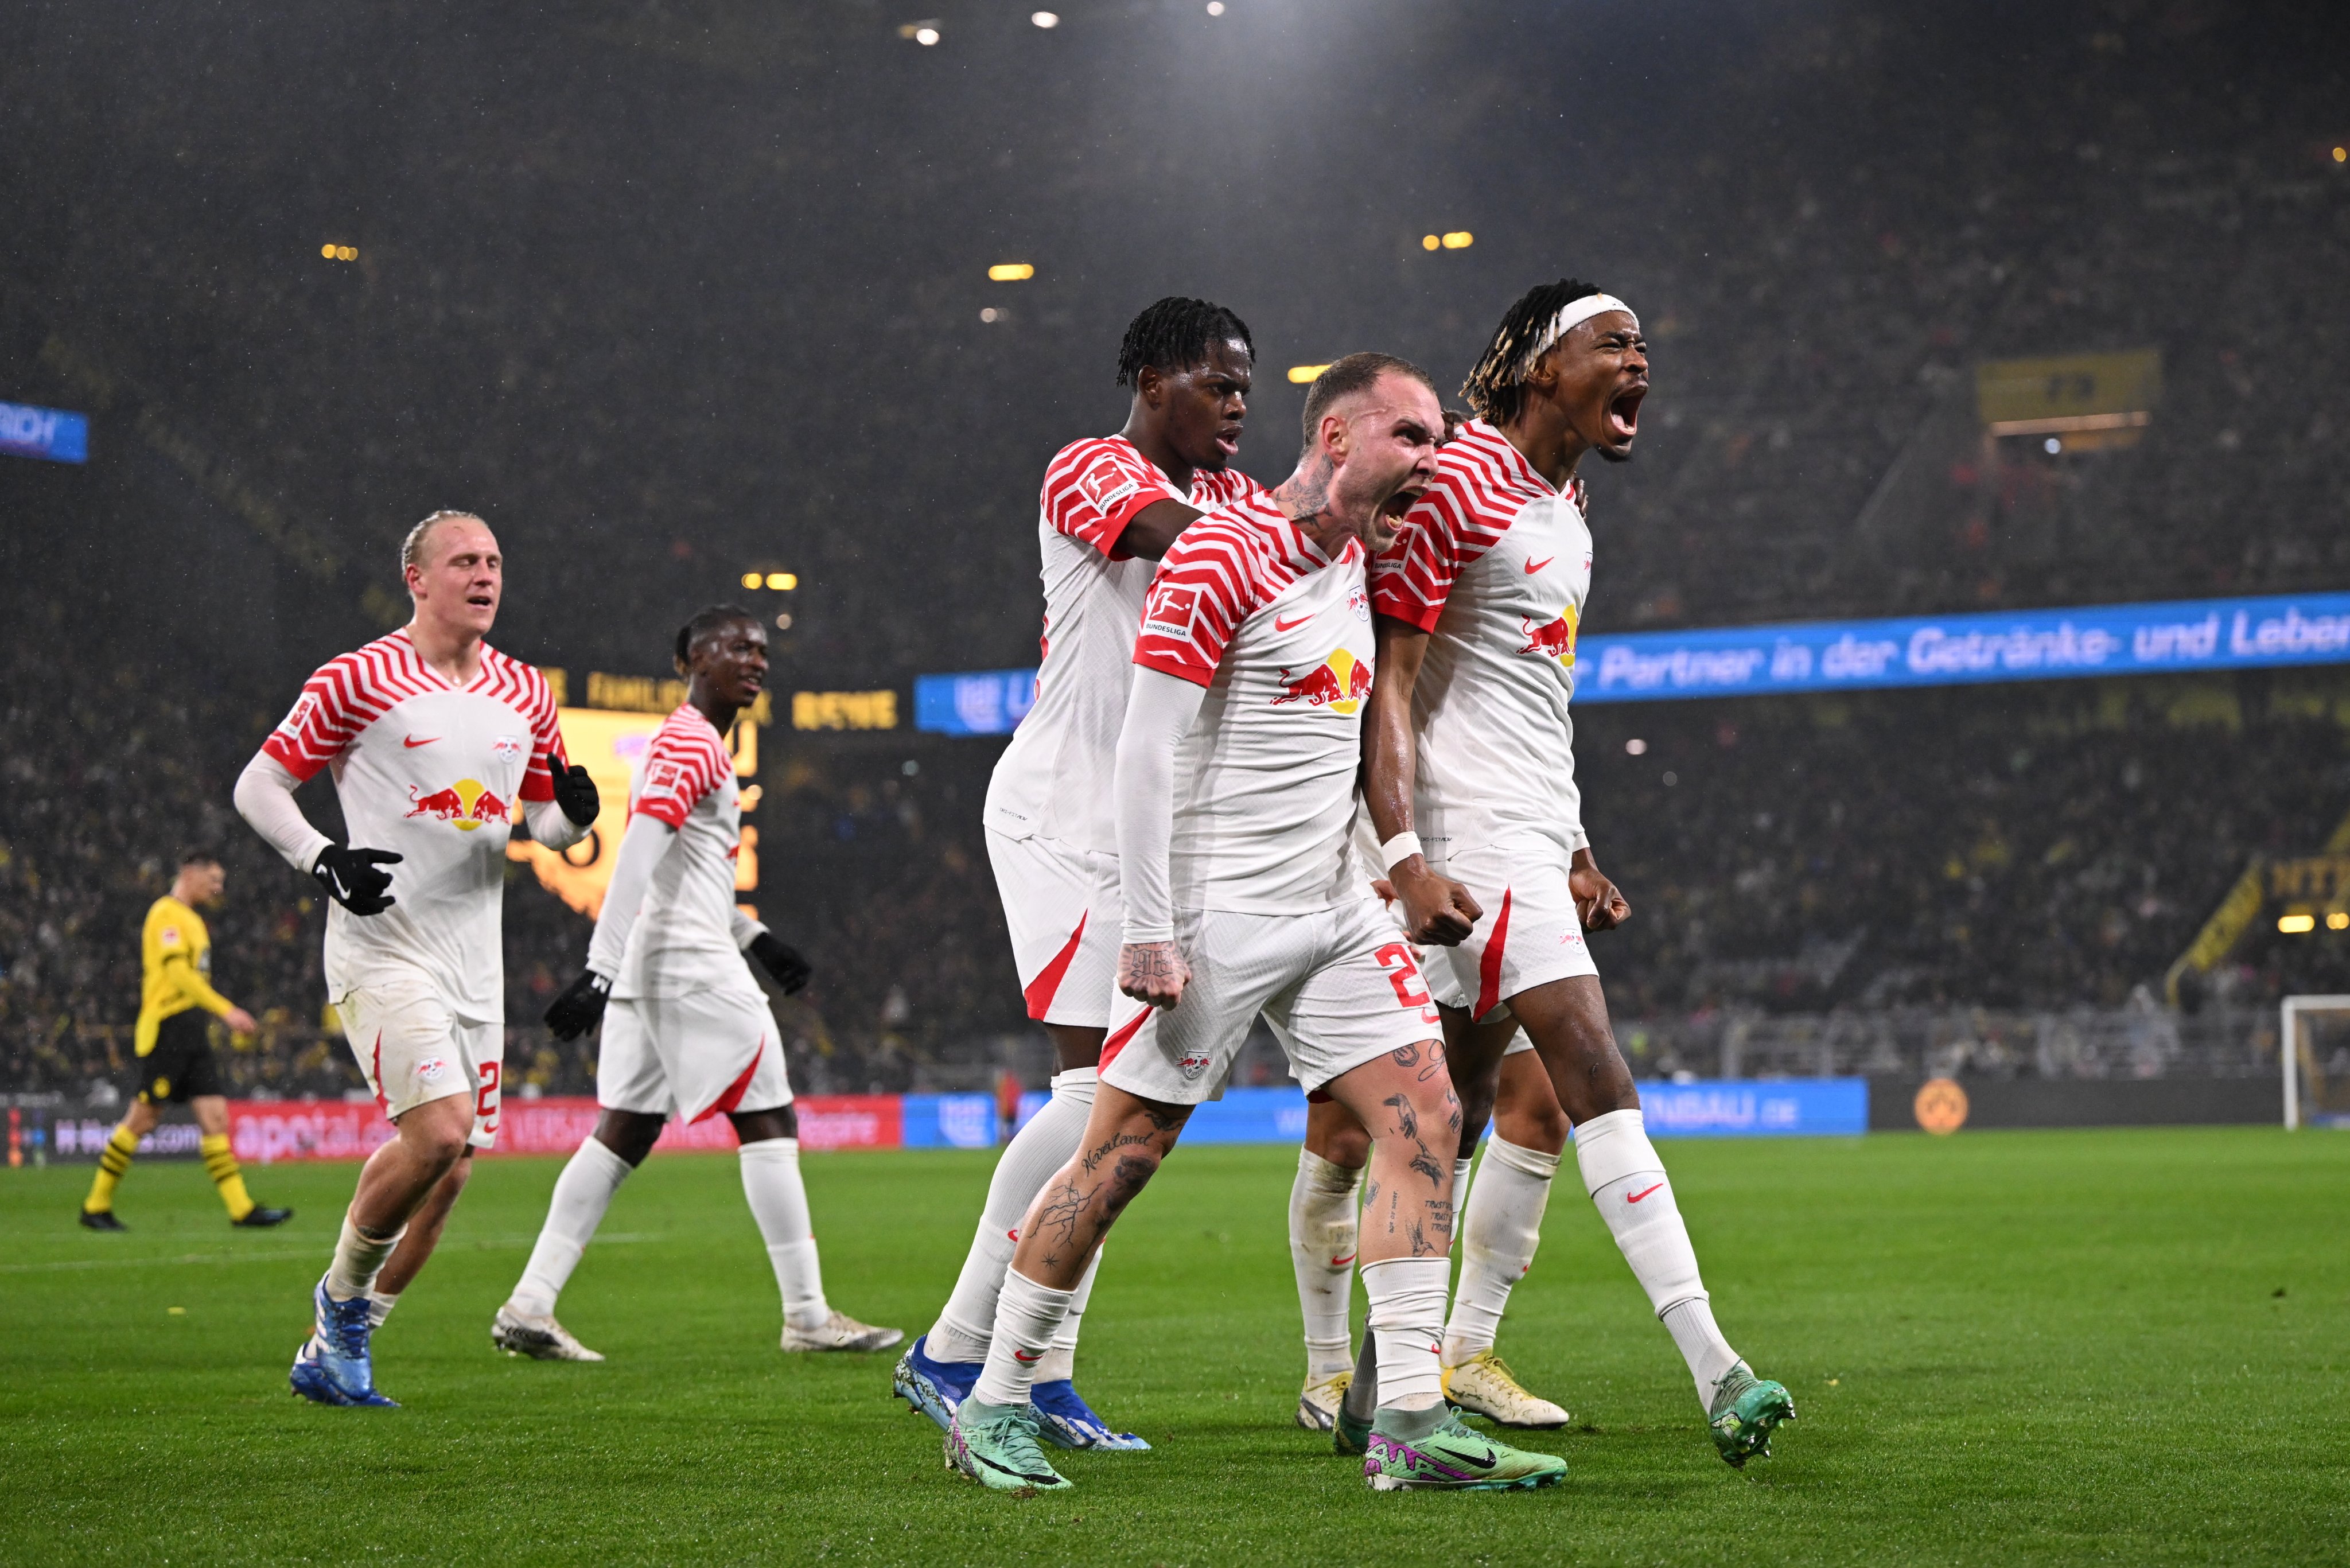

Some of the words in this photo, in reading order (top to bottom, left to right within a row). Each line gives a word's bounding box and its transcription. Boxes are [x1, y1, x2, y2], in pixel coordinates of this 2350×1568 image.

[1100, 483, 1134, 511] BUNDESLIGA
[1146, 623, 1186, 636] BUNDESLIGA
[1598, 645, 1764, 691] Partner
[1770, 636, 1813, 681] in
[1821, 632, 1899, 679] der
[2133, 612, 2220, 662] und
[1130, 948, 1173, 978] 98
[1375, 944, 1431, 1007] 2
[1082, 1132, 1154, 1177] Neverland
